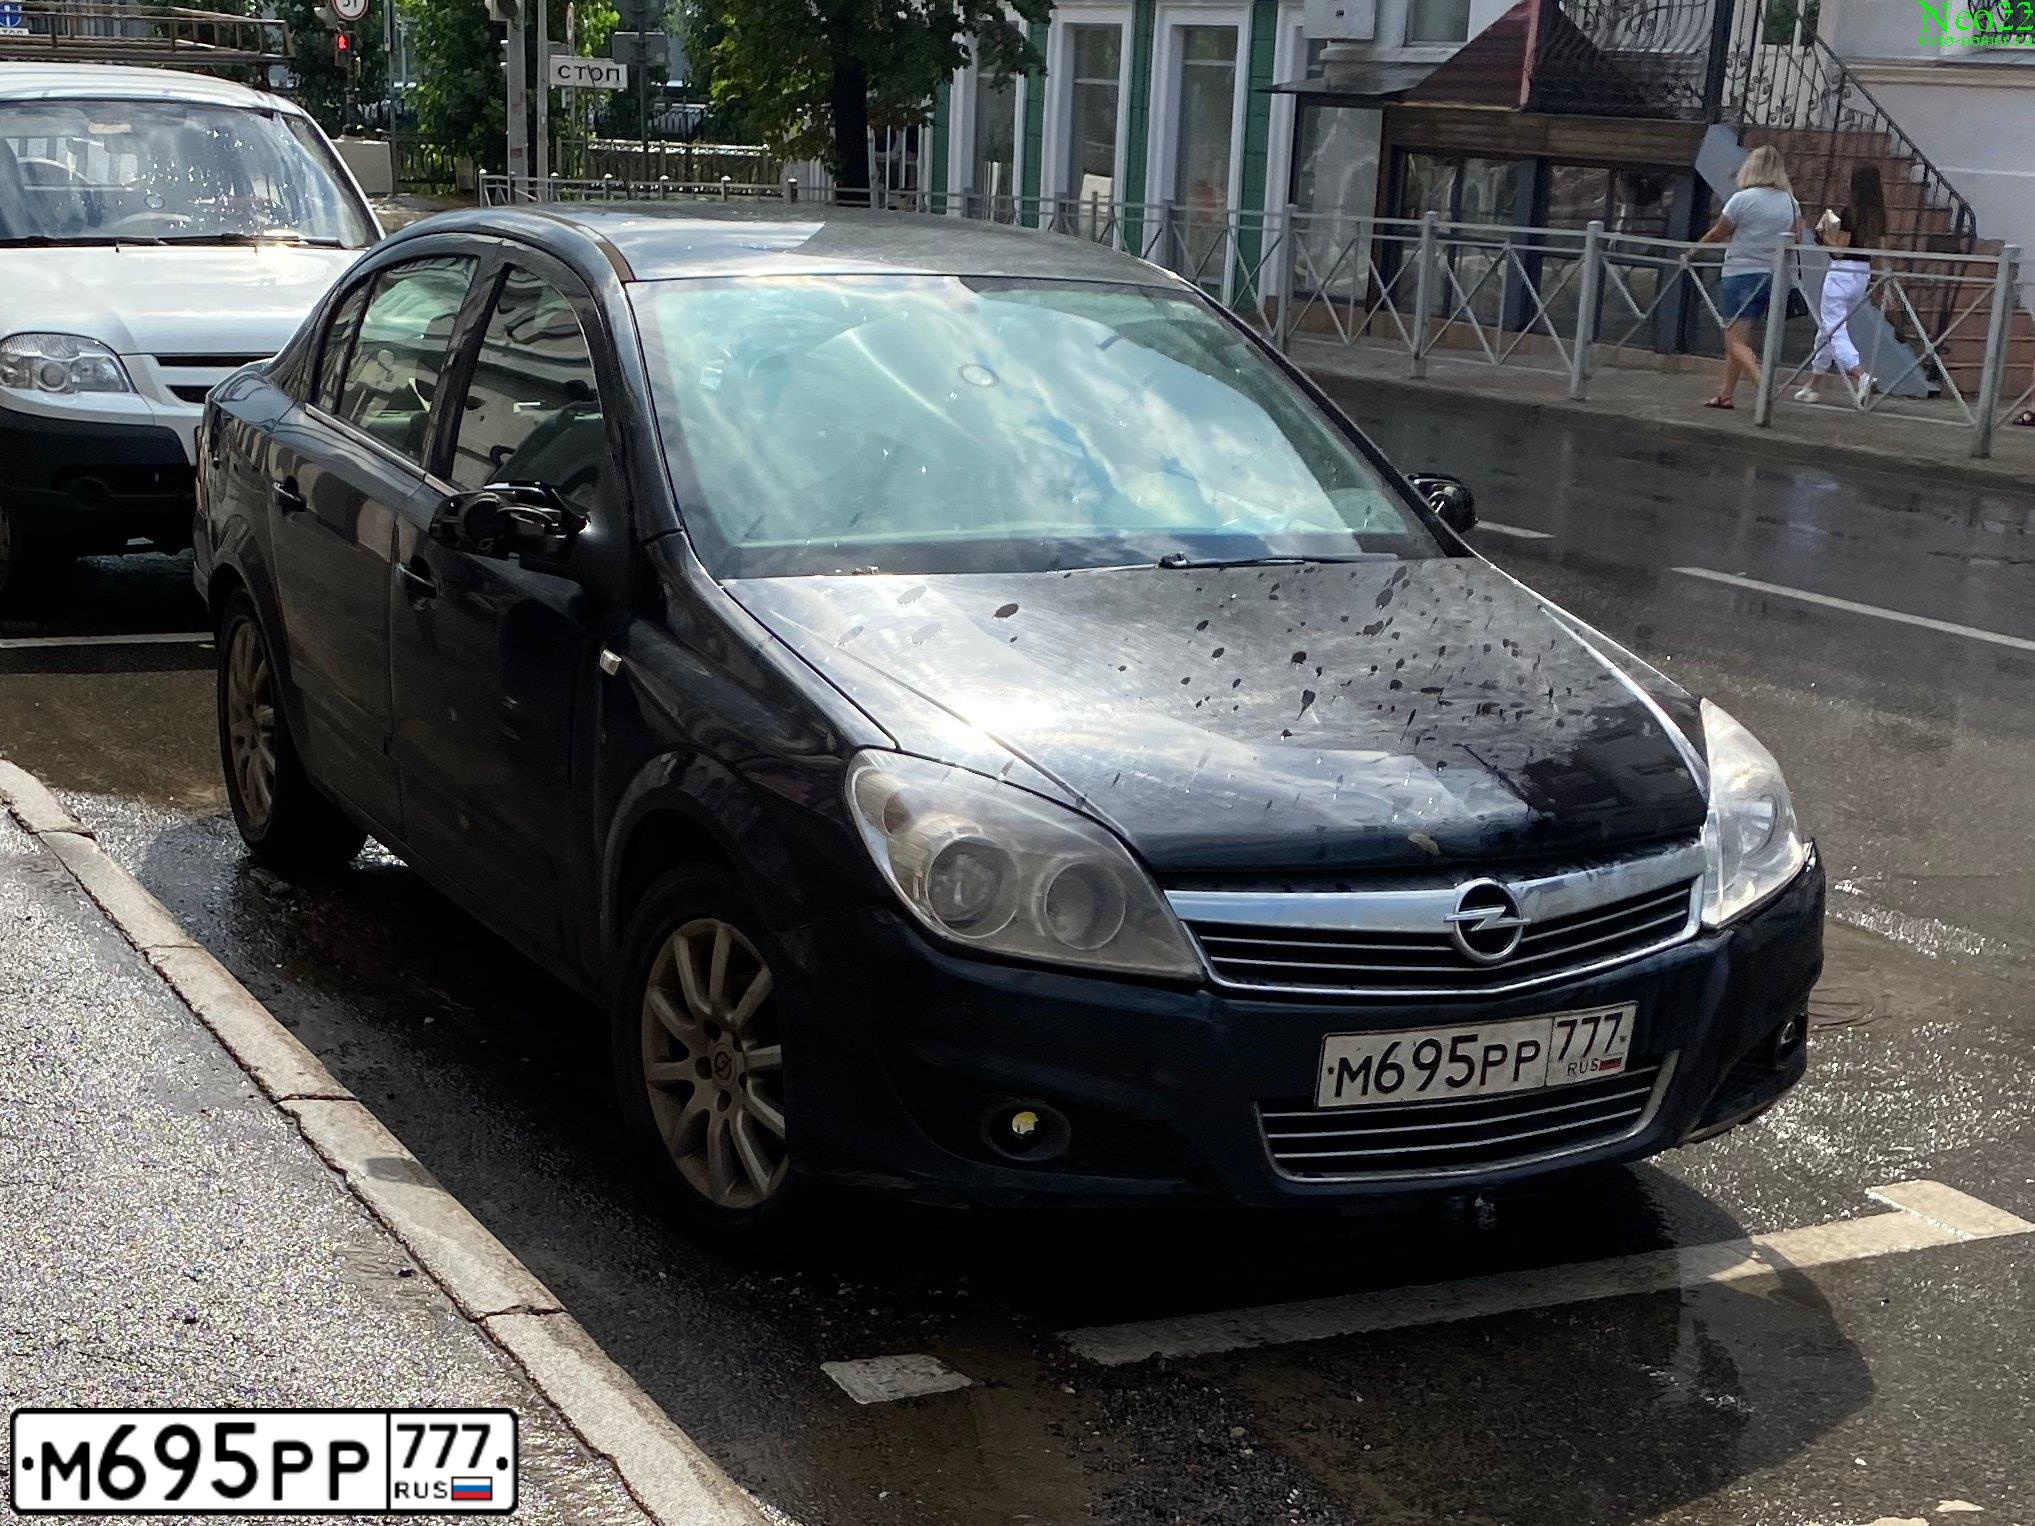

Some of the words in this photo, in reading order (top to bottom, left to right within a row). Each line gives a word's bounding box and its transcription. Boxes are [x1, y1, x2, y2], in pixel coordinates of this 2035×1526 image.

[557, 64, 620, 82] СТОП
[1557, 1011, 1624, 1062] 777
[1566, 1057, 1600, 1077] RUS
